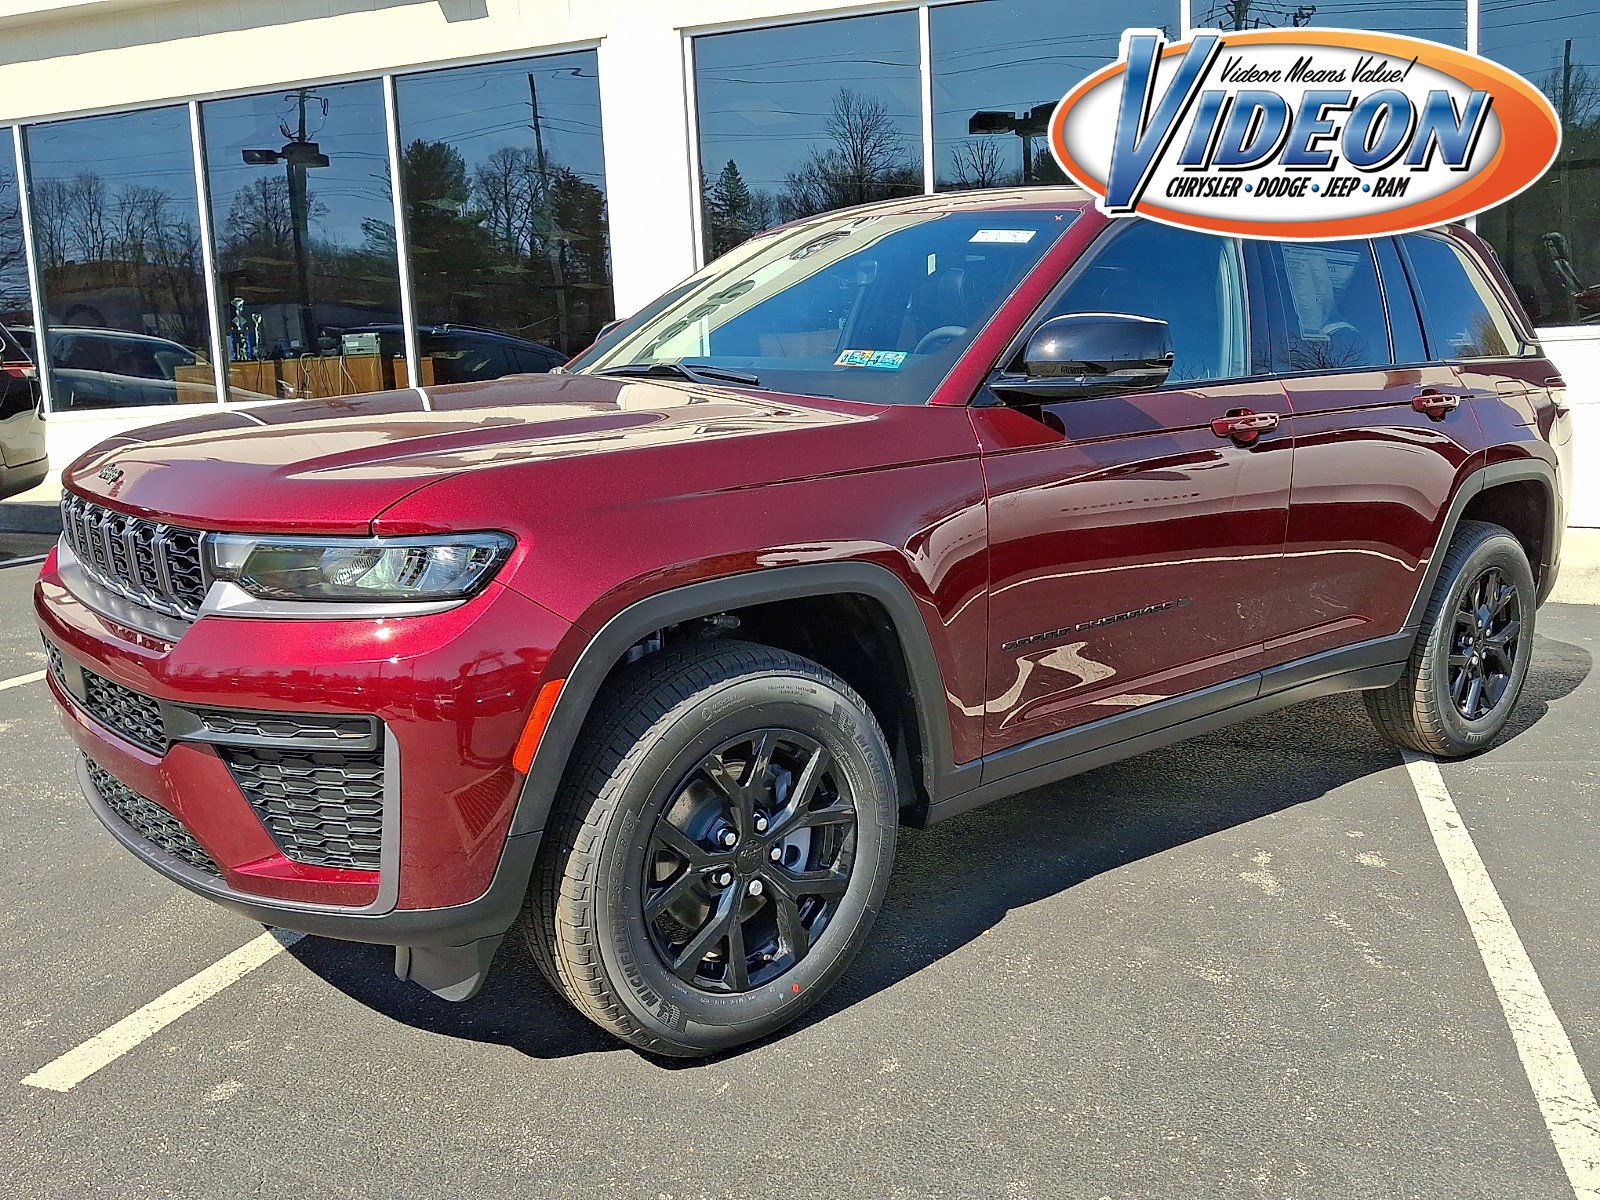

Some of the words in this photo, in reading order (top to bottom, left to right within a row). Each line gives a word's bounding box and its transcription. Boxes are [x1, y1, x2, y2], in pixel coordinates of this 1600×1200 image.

[1002, 626, 1070, 651] GRAND
[1075, 600, 1173, 632] CHEROKEE
[612, 920, 659, 1008] MICHELIN
